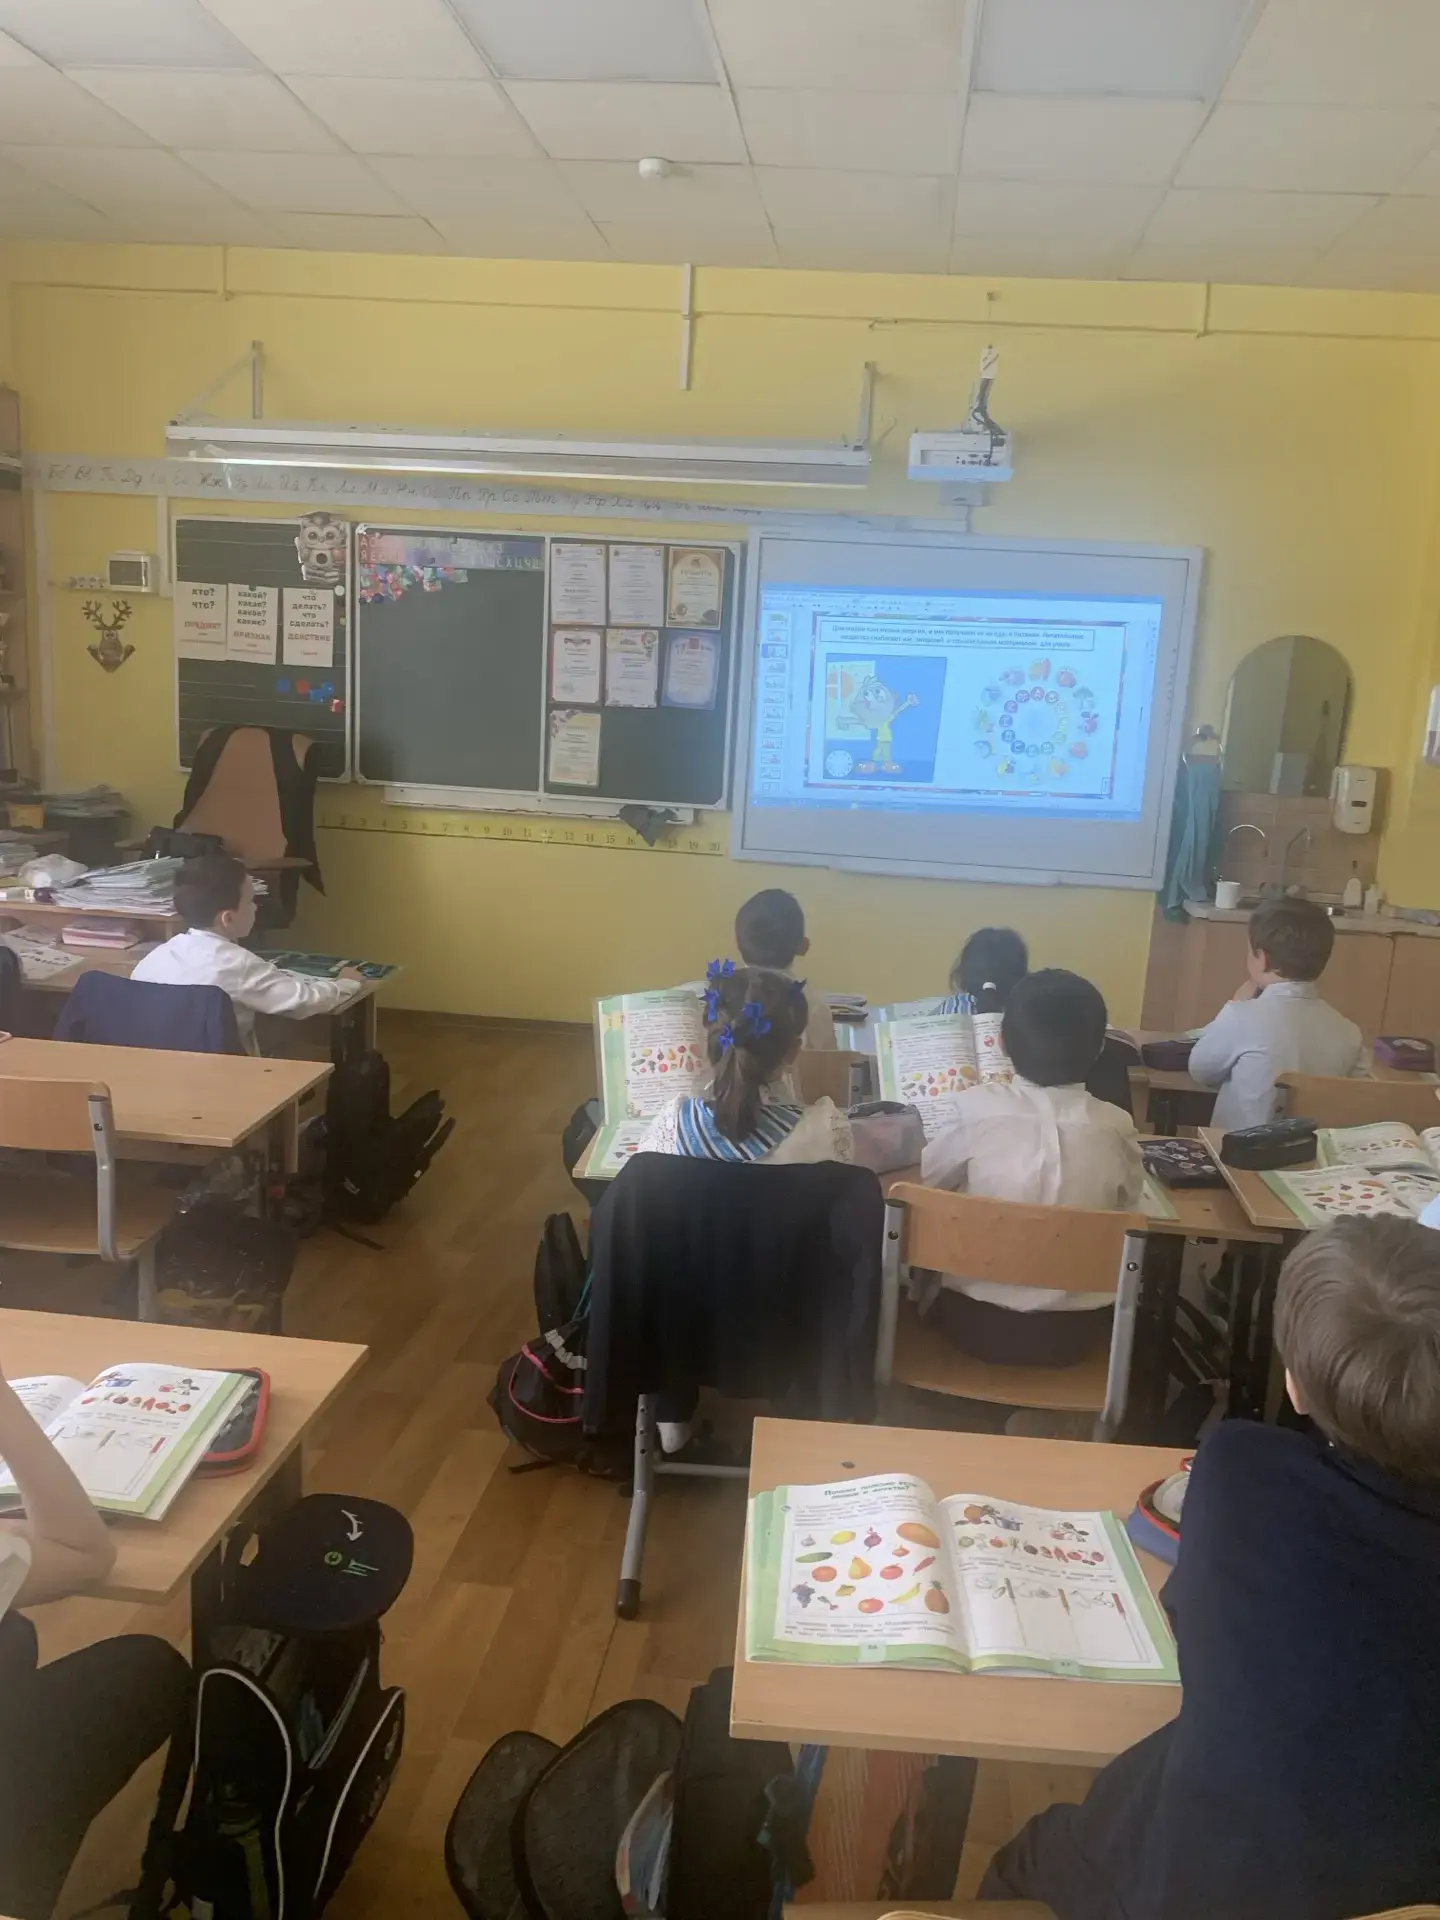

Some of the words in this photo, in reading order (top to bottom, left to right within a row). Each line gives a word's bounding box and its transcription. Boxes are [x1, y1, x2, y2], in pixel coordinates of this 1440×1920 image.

[192, 588, 215, 597] кто?
[237, 591, 267, 599] какой?
[192, 601, 215, 609] что?
[237, 600, 267, 608] какая?
[291, 603, 327, 612] делать?
[237, 609, 267, 617] какое?
[236, 618, 267, 626] какие?
[289, 620, 330, 628] сделать?
[233, 631, 271, 641] ПРИЗНАК
[288, 632, 331, 642] ДЕЙСТВИЕ
[502, 827, 512, 836] 10
[523, 828, 533, 837] 11
[565, 832, 575, 841] 13
[606, 835, 616, 844] 15
[689, 841, 701, 850] 19
